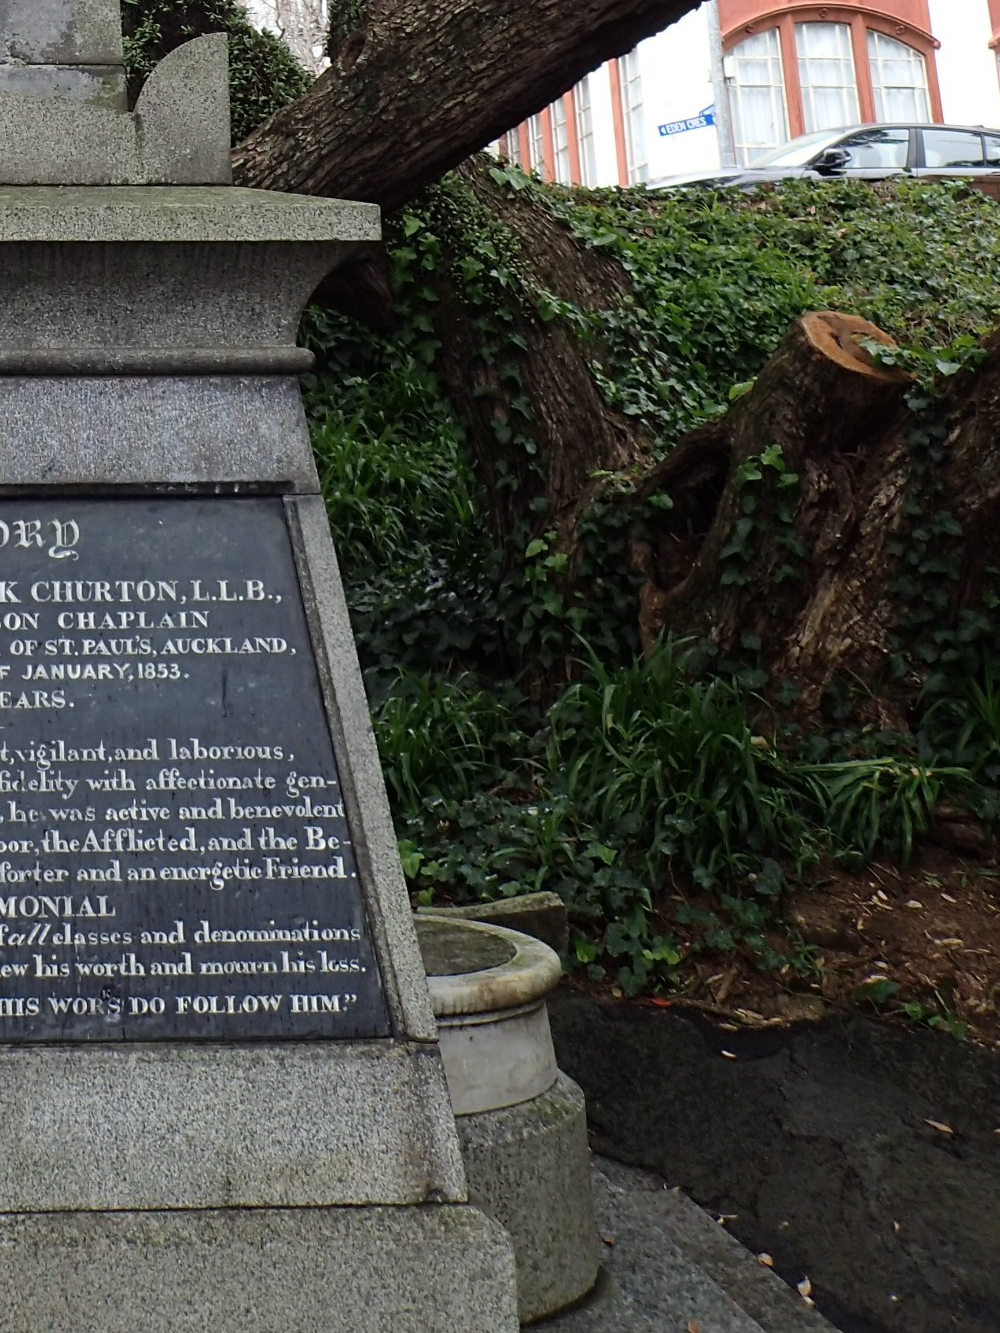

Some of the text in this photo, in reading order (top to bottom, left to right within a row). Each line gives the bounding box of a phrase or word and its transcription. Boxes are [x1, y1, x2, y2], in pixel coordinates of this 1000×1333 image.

[666, 117, 707, 133] EDEN CRES
[30, 580, 187, 605] CHURTON,
[57, 611, 210, 630] CHAPLAIN
[10, 640, 38, 656] OF
[44, 639, 80, 656] ST.
[161, 637, 297, 656] AUCKLAND,
[21, 664, 134, 682] JANUARY,
[137, 662, 190, 680] 1853.
[15, 740, 113, 770] vigilant,
[114, 739, 159, 761] and
[168, 738, 295, 762] laborious,
[85, 769, 136, 791] with
[145, 768, 276, 790] affectionate
[286, 770, 337, 798] gen-
[7, 800, 39, 823] he
[48, 806, 96, 822] was
[104, 798, 171, 821] active
[178, 797, 226, 820] and
[228, 796, 345, 819] benevolent
[80, 827, 206, 856] Afflicted,
[207, 827, 254, 850] and
[258, 827, 298, 850] the
[304, 826, 352, 850] Be-
[76, 860, 122, 882] and
[159, 859, 262, 891] energetic
[263, 856, 357, 879] Friend.
[52, 923, 132, 945] classes
[140, 920, 186, 944] and
[193, 919, 361, 943] denominations
[32, 954, 70, 977] his
[75, 953, 145, 977] worth
[150, 952, 194, 976] and
[280, 951, 315, 973] his
[129, 996, 166, 1014] DO
[175, 994, 283, 1014] FOLLOW
